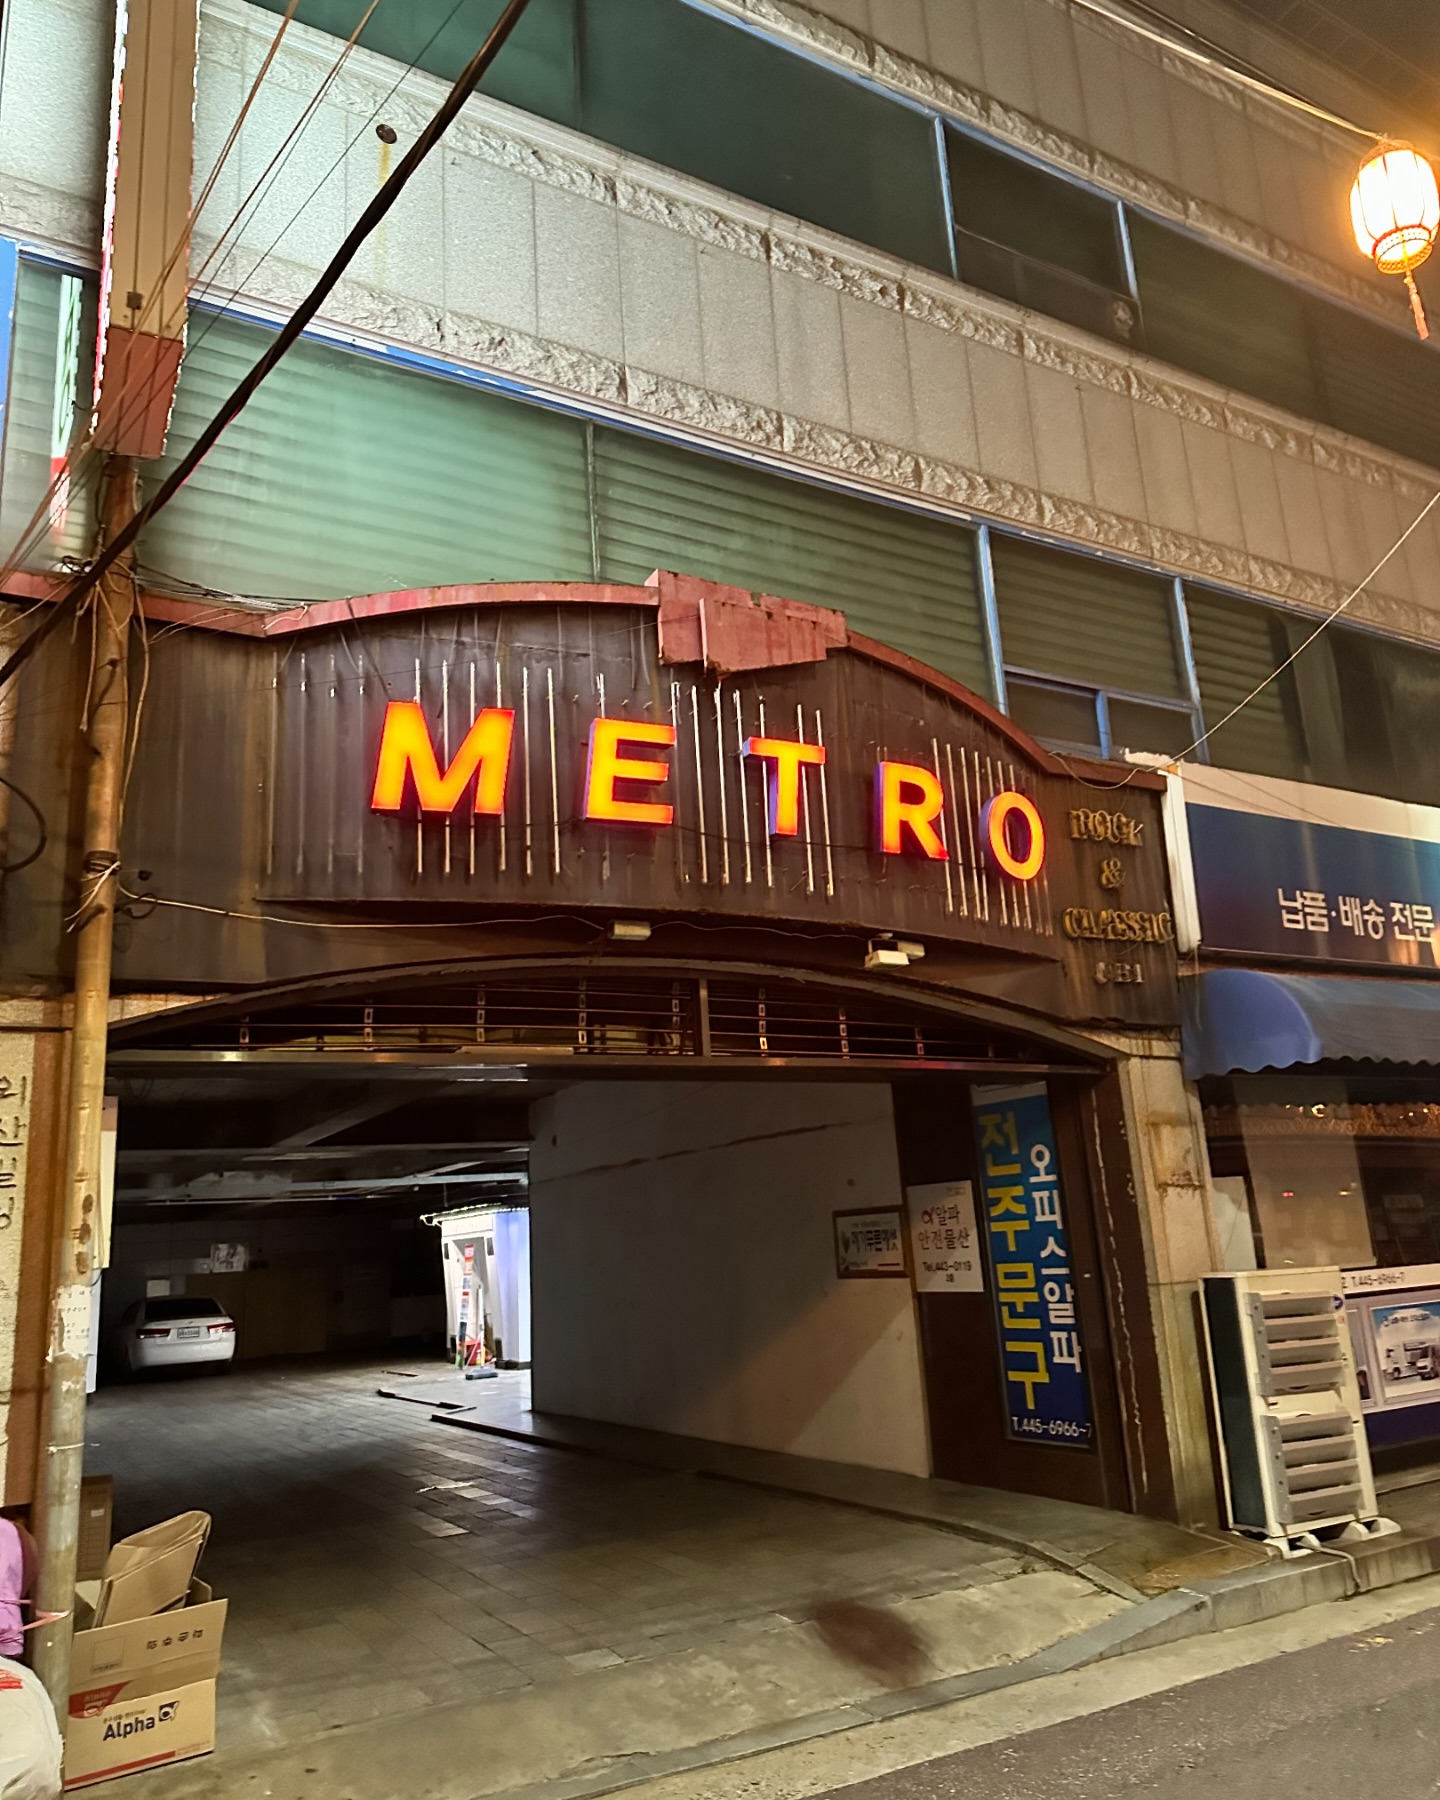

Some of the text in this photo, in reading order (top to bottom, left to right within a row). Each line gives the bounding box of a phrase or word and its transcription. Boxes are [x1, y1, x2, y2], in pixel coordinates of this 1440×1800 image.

[371, 701, 1046, 881] METRO
[1069, 808, 1144, 847] ROCK
[1099, 857, 1126, 890] &
[1063, 907, 1175, 945] CLASSIC
[1277, 887, 1436, 943] 납품·배송 전문
[918, 1227, 970, 1250] 안전물산
[978, 1110, 1050, 1410] 전주문구
[1029, 1143, 1083, 1374] 오피스알파
[103, 1716, 155, 1742] Alpha
